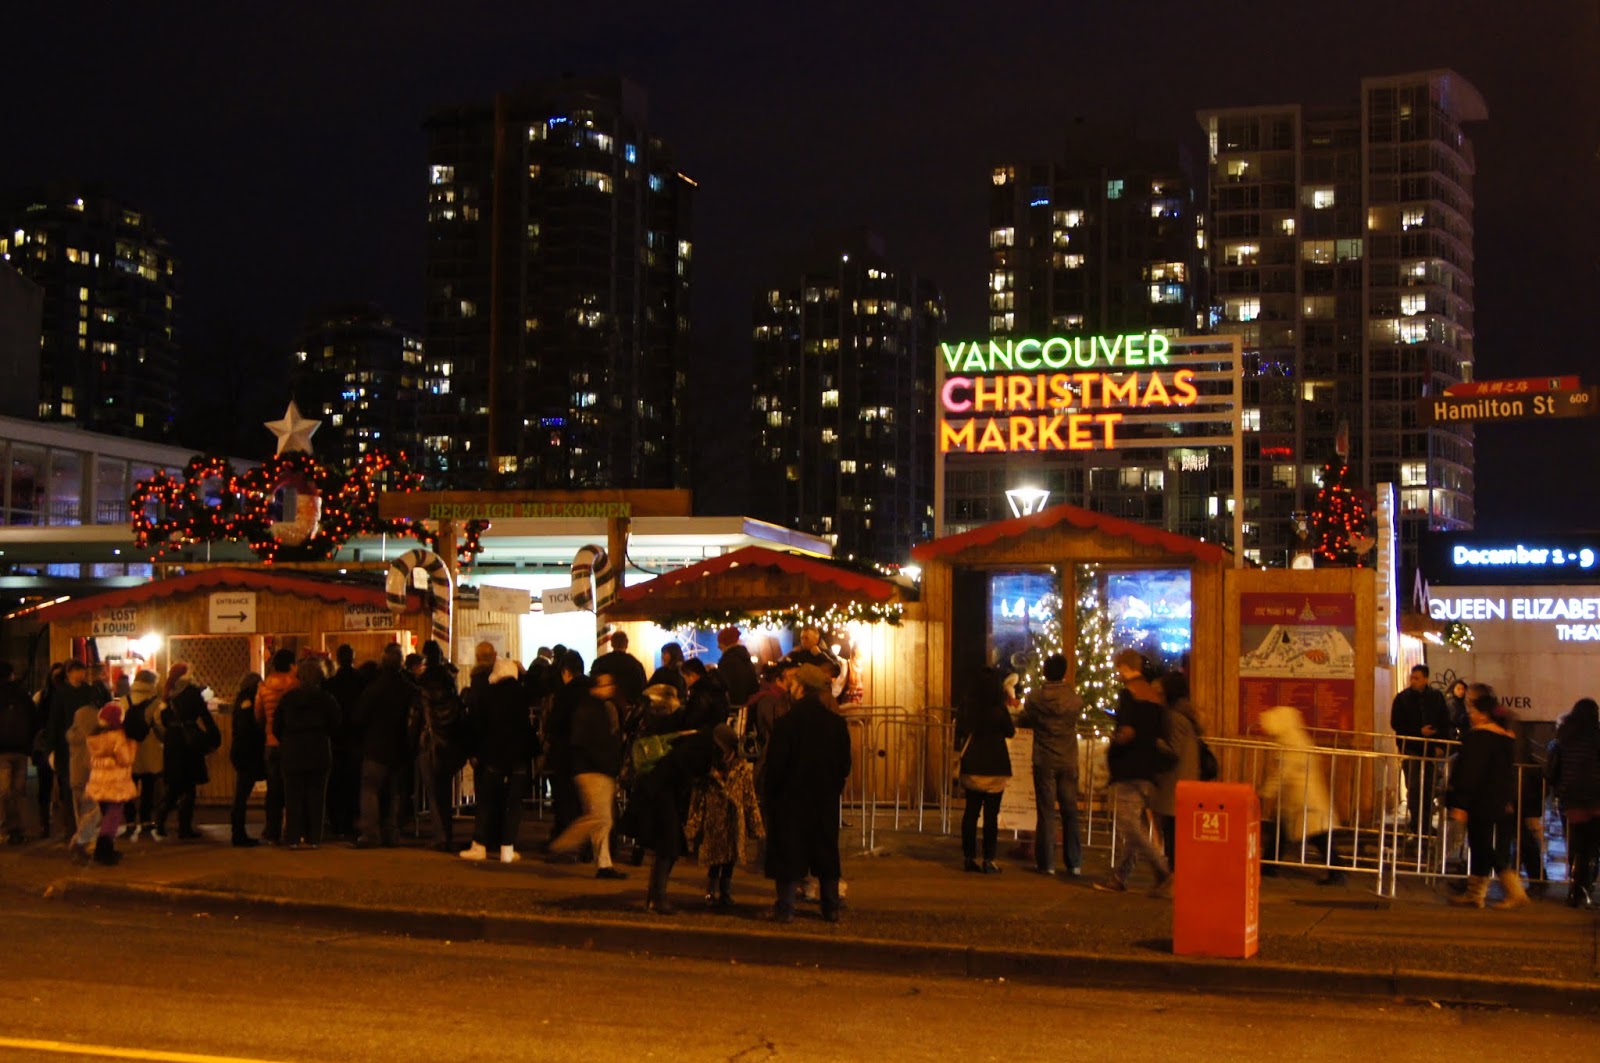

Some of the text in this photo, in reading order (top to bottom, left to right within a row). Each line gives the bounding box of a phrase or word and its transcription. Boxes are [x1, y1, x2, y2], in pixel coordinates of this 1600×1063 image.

[941, 334, 1169, 372] VANCOUVER
[941, 369, 1198, 412] CHRISTMAS
[1434, 393, 1589, 421] Hamilton St 600
[940, 413, 1123, 453] MARKET
[429, 502, 631, 518] HERZLICH WILLKOMMEN
[1453, 545, 1549, 565] December
[216, 597, 249, 605] ENTRANCE
[1429, 598, 1505, 620] QUEEN
[111, 610, 136, 621] LOST
[365, 616, 393, 627] & GIFTS
[93, 622, 136, 633] & FOUND
[1202, 814, 1220, 829] 24
